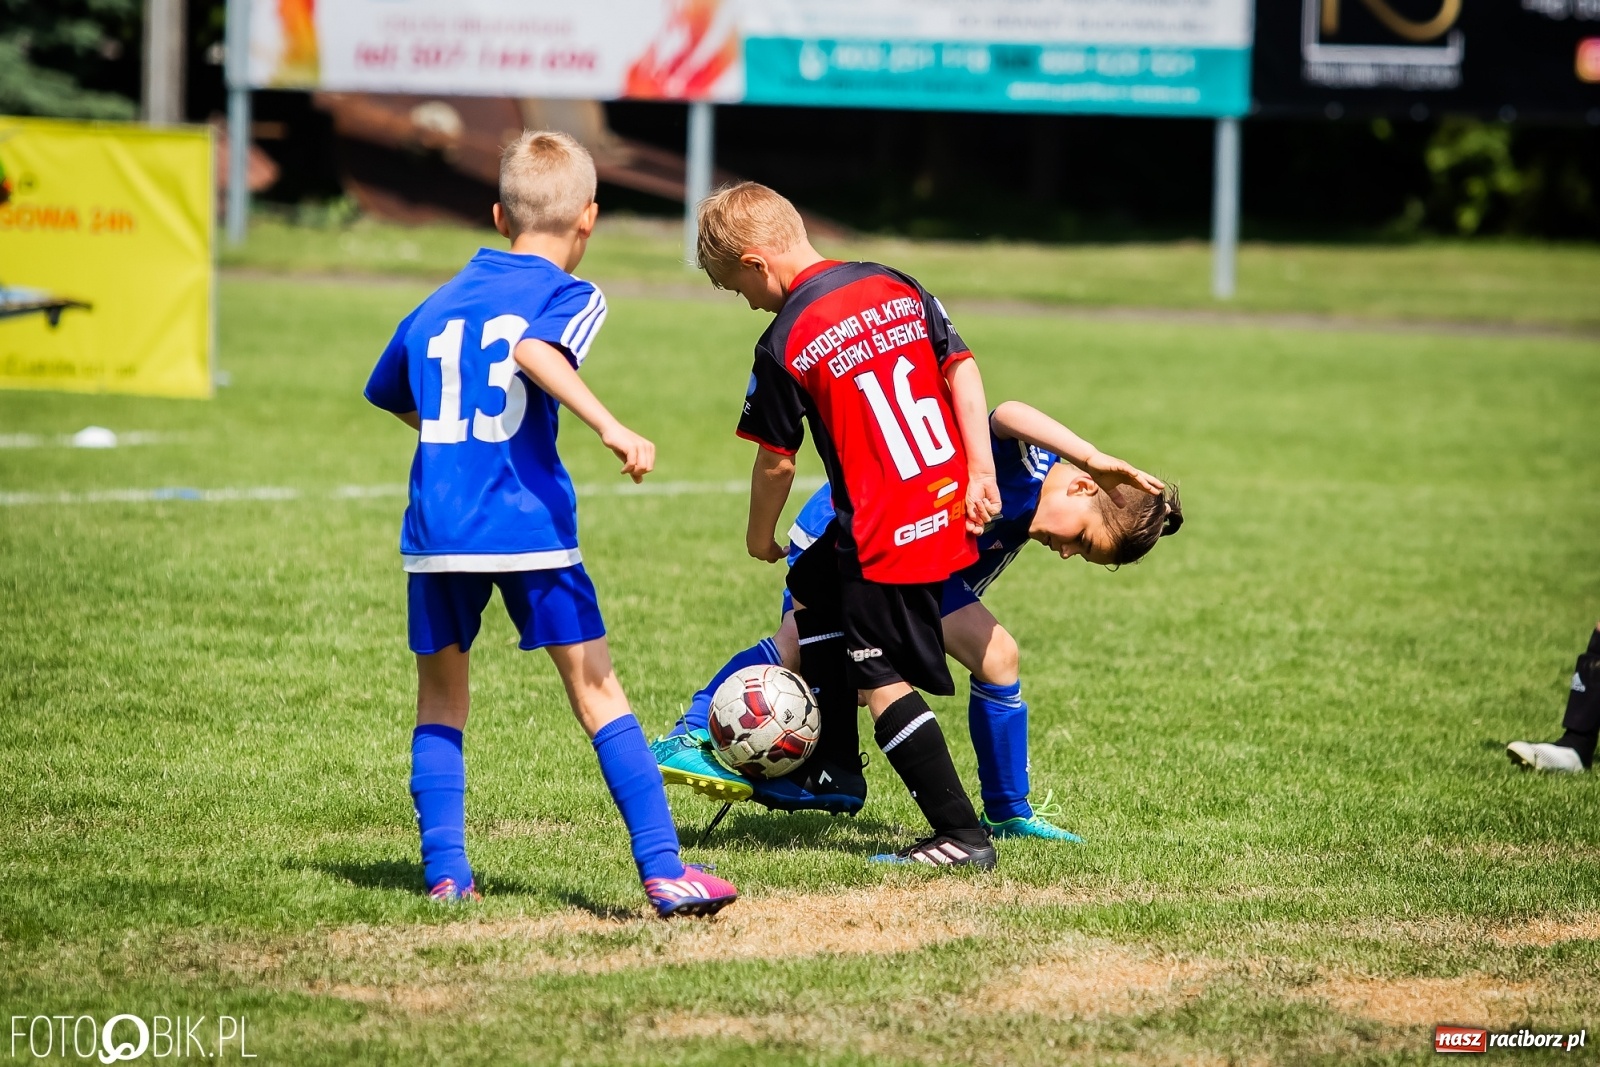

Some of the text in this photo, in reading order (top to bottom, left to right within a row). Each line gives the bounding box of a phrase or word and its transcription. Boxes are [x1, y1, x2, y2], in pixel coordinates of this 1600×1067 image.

[420, 314, 530, 444] 13
[791, 297, 925, 376] AKADEMIA PIŁKAR
[827, 339, 874, 378] GÓRKI
[854, 355, 956, 481] 16
